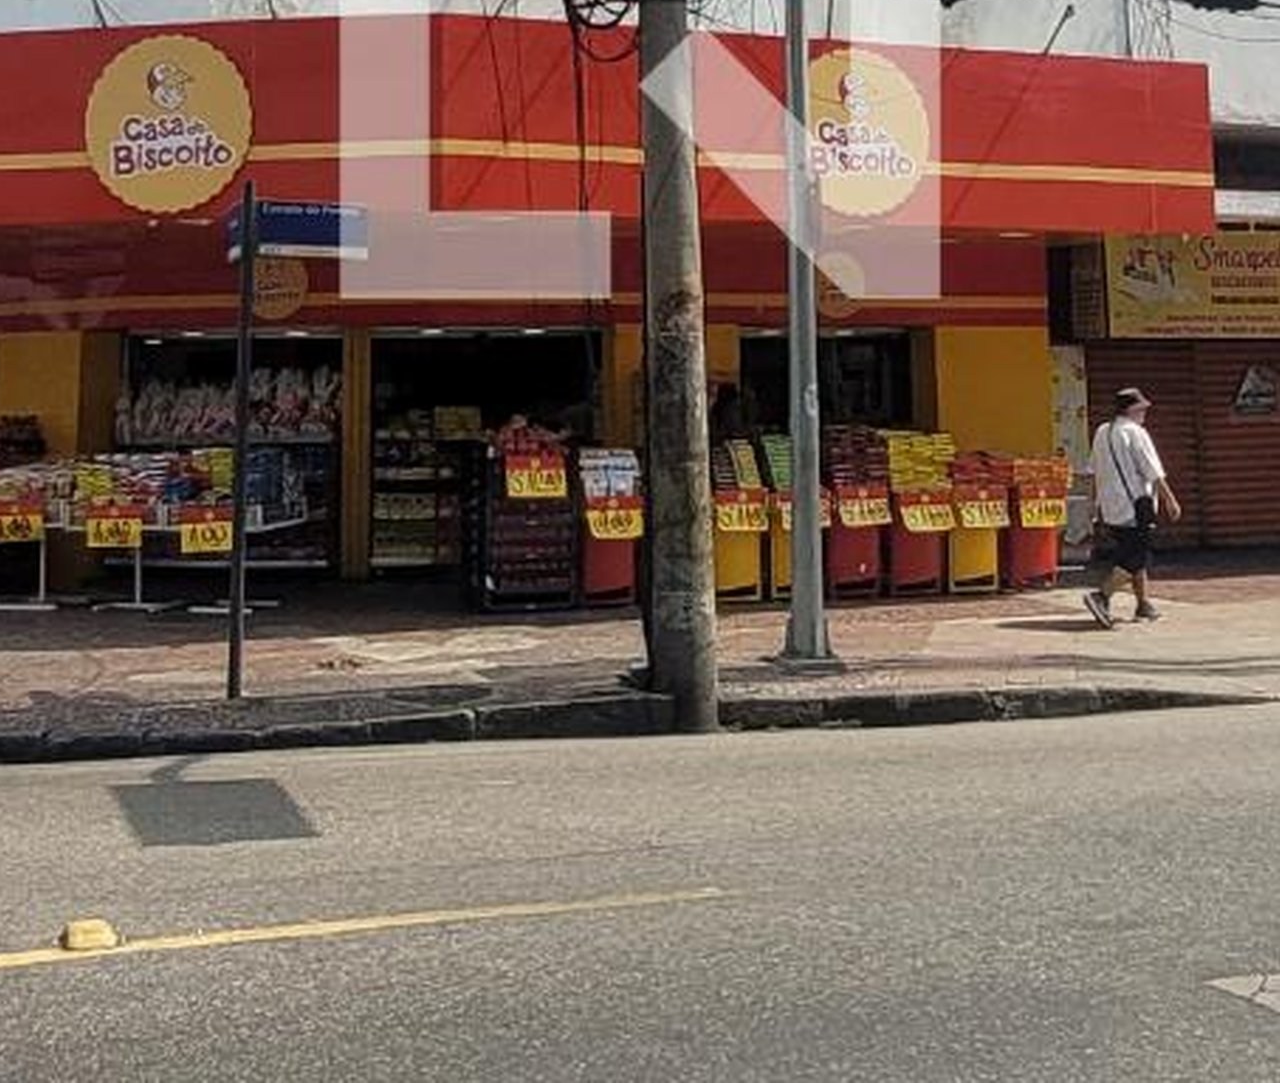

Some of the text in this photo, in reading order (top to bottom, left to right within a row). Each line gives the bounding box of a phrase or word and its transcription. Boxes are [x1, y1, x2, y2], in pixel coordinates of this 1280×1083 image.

[123, 117, 184, 141] Casa
[818, 121, 871, 146] Casa
[114, 135, 233, 175] Biscoito
[810, 146, 913, 176] Biscoito
